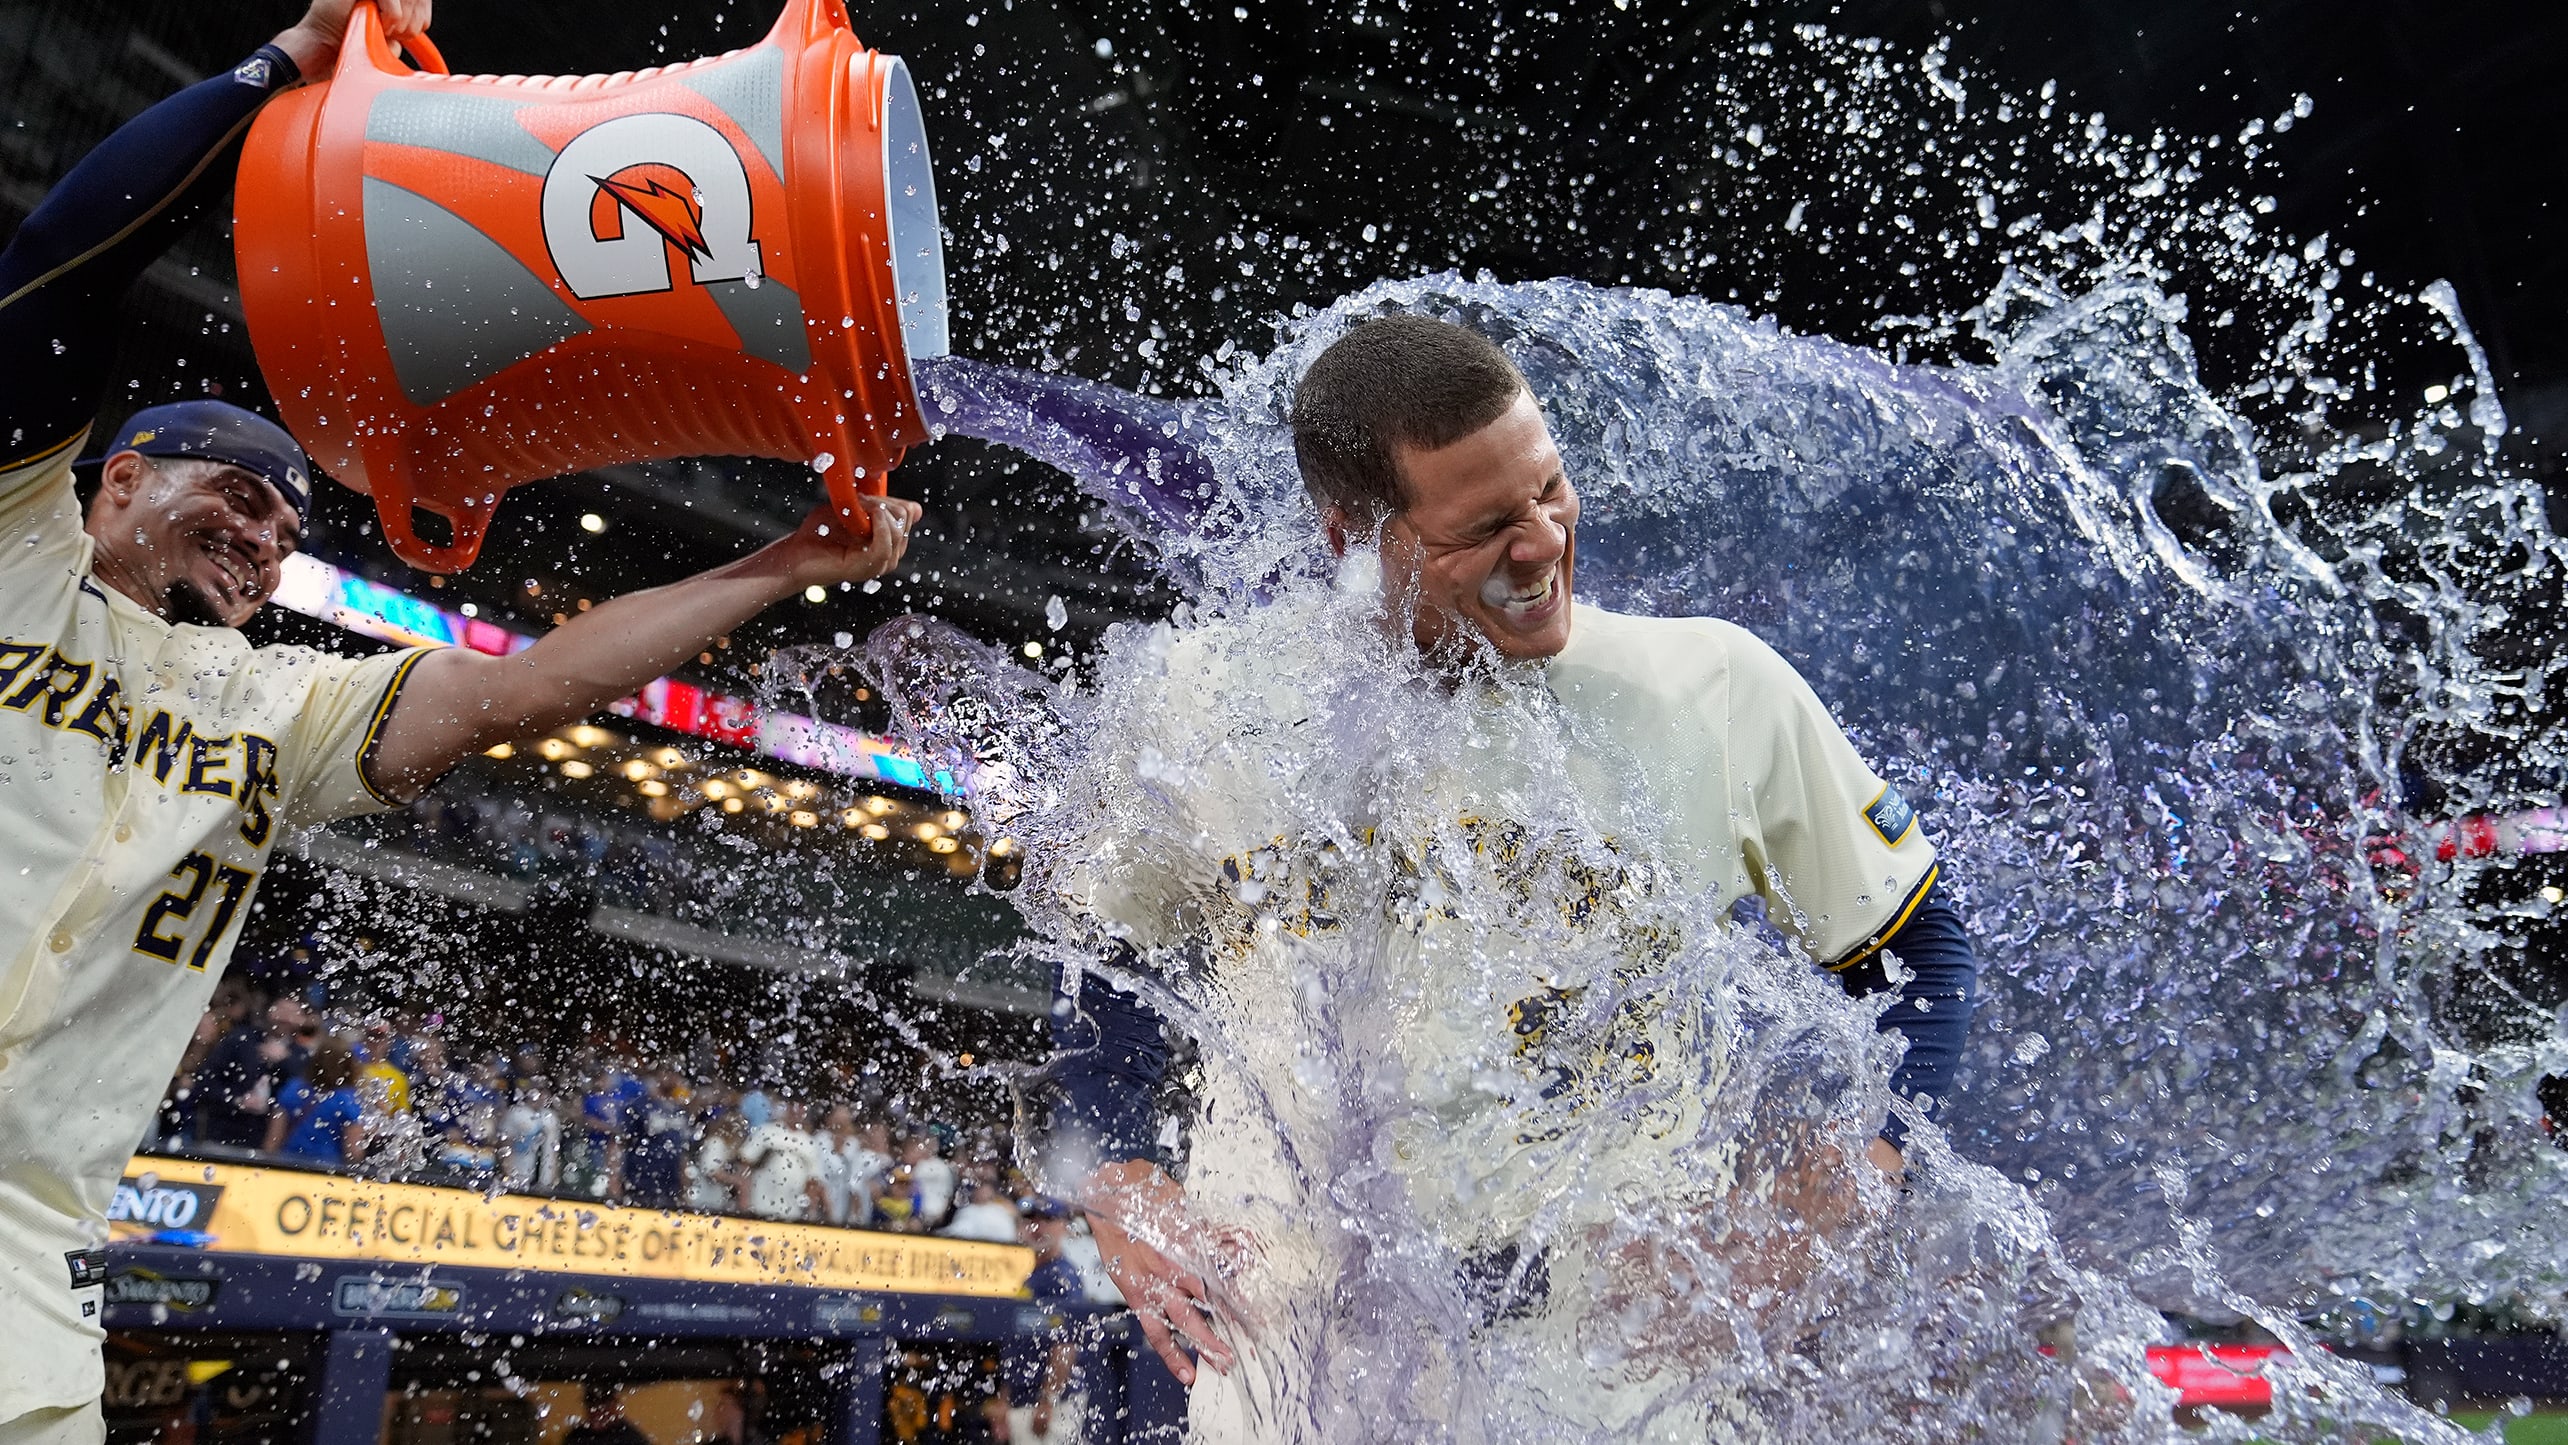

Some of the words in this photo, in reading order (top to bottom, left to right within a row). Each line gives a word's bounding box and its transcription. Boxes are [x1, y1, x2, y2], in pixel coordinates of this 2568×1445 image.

[278, 1195, 478, 1248] OFFICIAL
[493, 1214, 630, 1260] CHEESE
[643, 1229, 683, 1261] OF
[693, 1232, 746, 1269] THE
